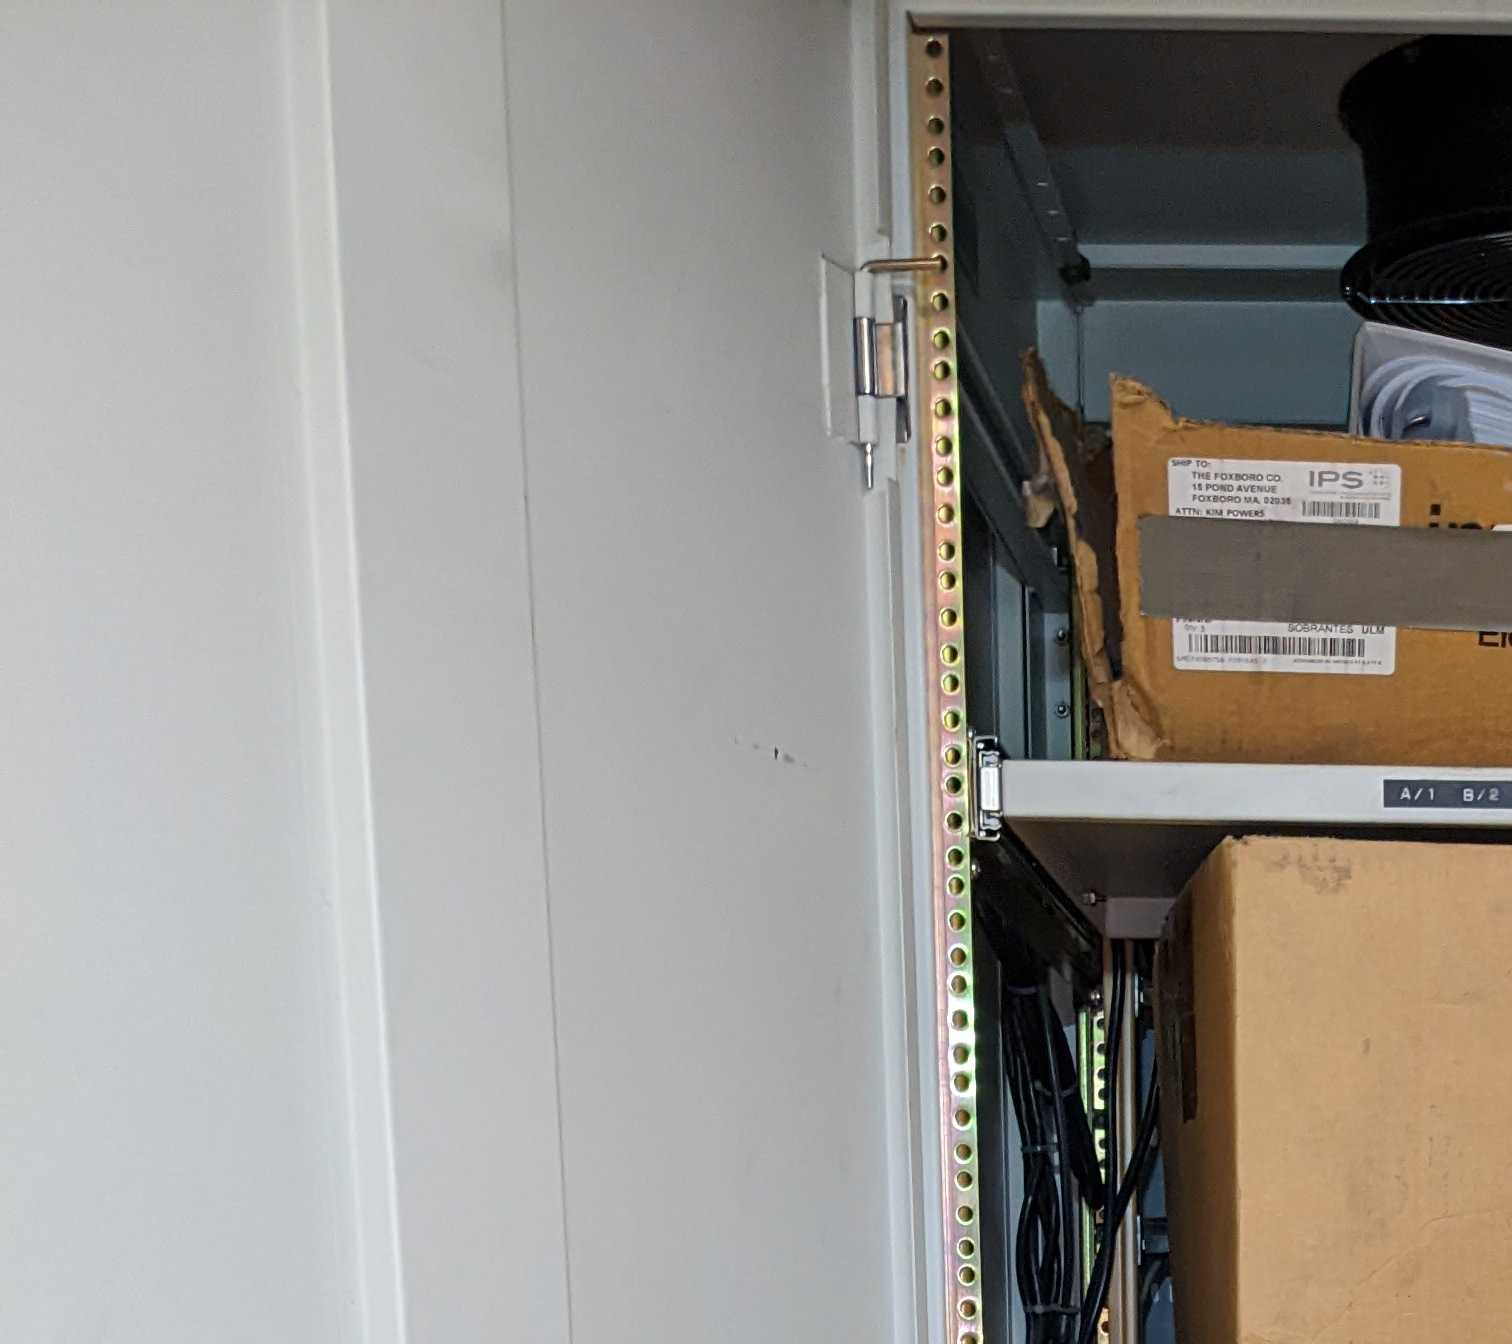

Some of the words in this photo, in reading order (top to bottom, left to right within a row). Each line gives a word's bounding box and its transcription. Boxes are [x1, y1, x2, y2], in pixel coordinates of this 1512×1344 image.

[1192, 472, 1211, 480] THE
[1214, 472, 1264, 481] FOXBORO
[1309, 470, 1364, 489] IPS
[1205, 484, 1234, 493] POND
[1236, 485, 1278, 493] AVENUE
[1192, 495, 1241, 503] FOXBORO
[1400, 787, 1434, 801] A/1
[1463, 788, 1500, 802] B/2
